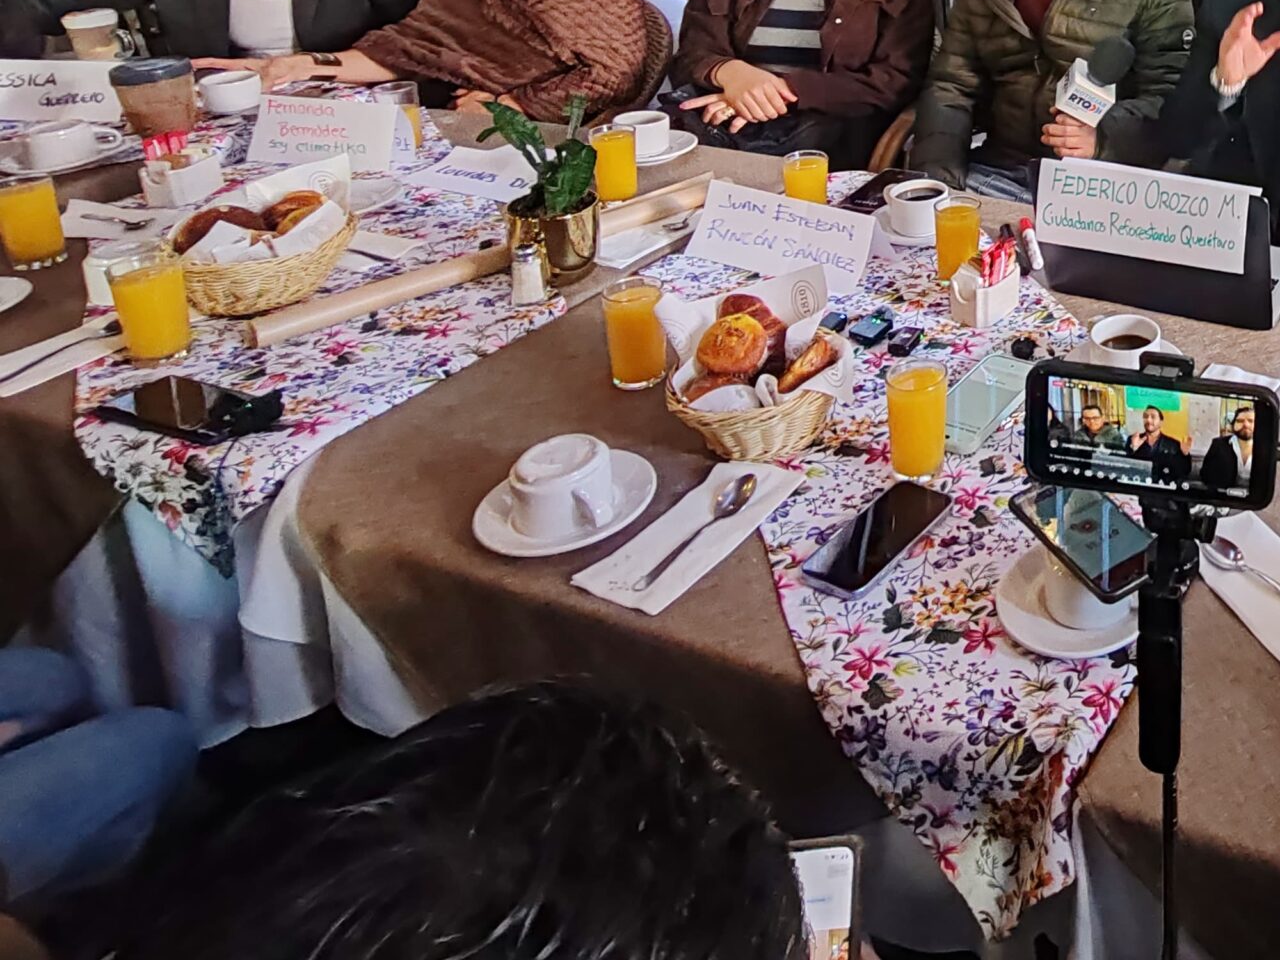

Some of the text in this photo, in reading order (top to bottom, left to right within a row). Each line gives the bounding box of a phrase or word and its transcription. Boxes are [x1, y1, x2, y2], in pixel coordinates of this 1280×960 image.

[267, 99, 335, 117] Fernanda
[1052, 167, 1241, 220] FEDERICO OROZCO M.
[772, 202, 855, 241] ESTEBAN
[1042, 202, 1106, 232] Ciudadanos
[1109, 212, 1176, 244] Reforestando
